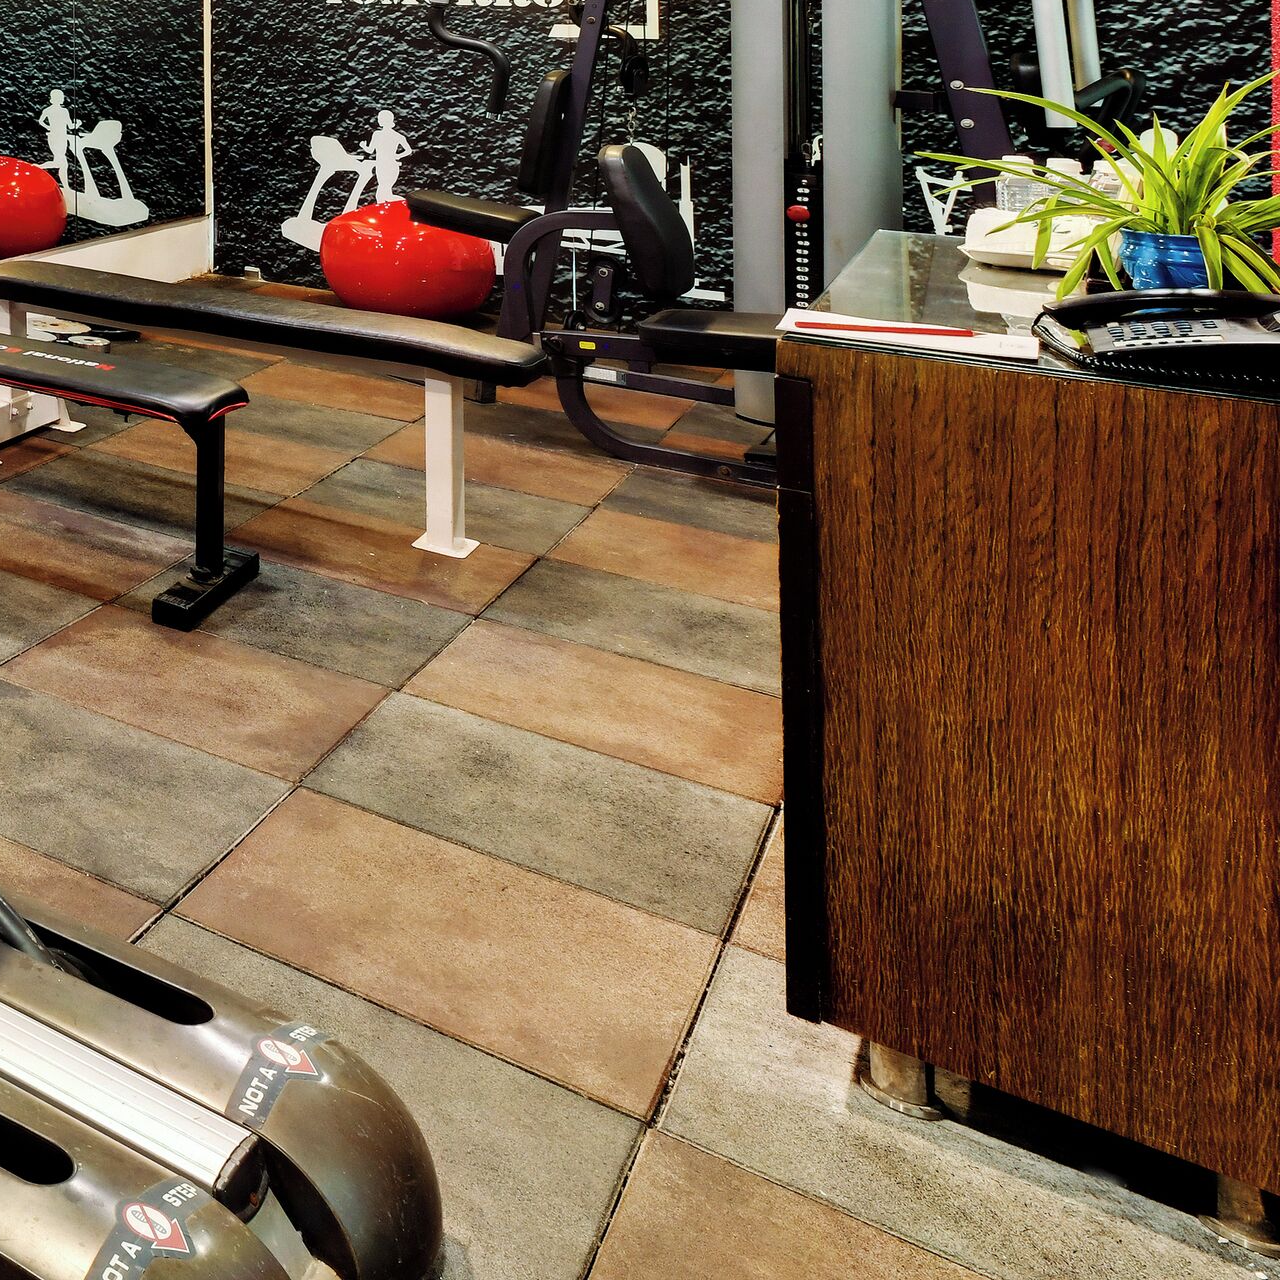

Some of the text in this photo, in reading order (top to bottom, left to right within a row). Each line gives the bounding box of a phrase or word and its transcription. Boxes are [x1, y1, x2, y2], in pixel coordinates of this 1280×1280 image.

[22, 350, 116, 371] National
[238, 1077, 269, 1117] NOT
[259, 1066, 277, 1081] A
[120, 1241, 142, 1259] A
[161, 1182, 198, 1208] STEP
